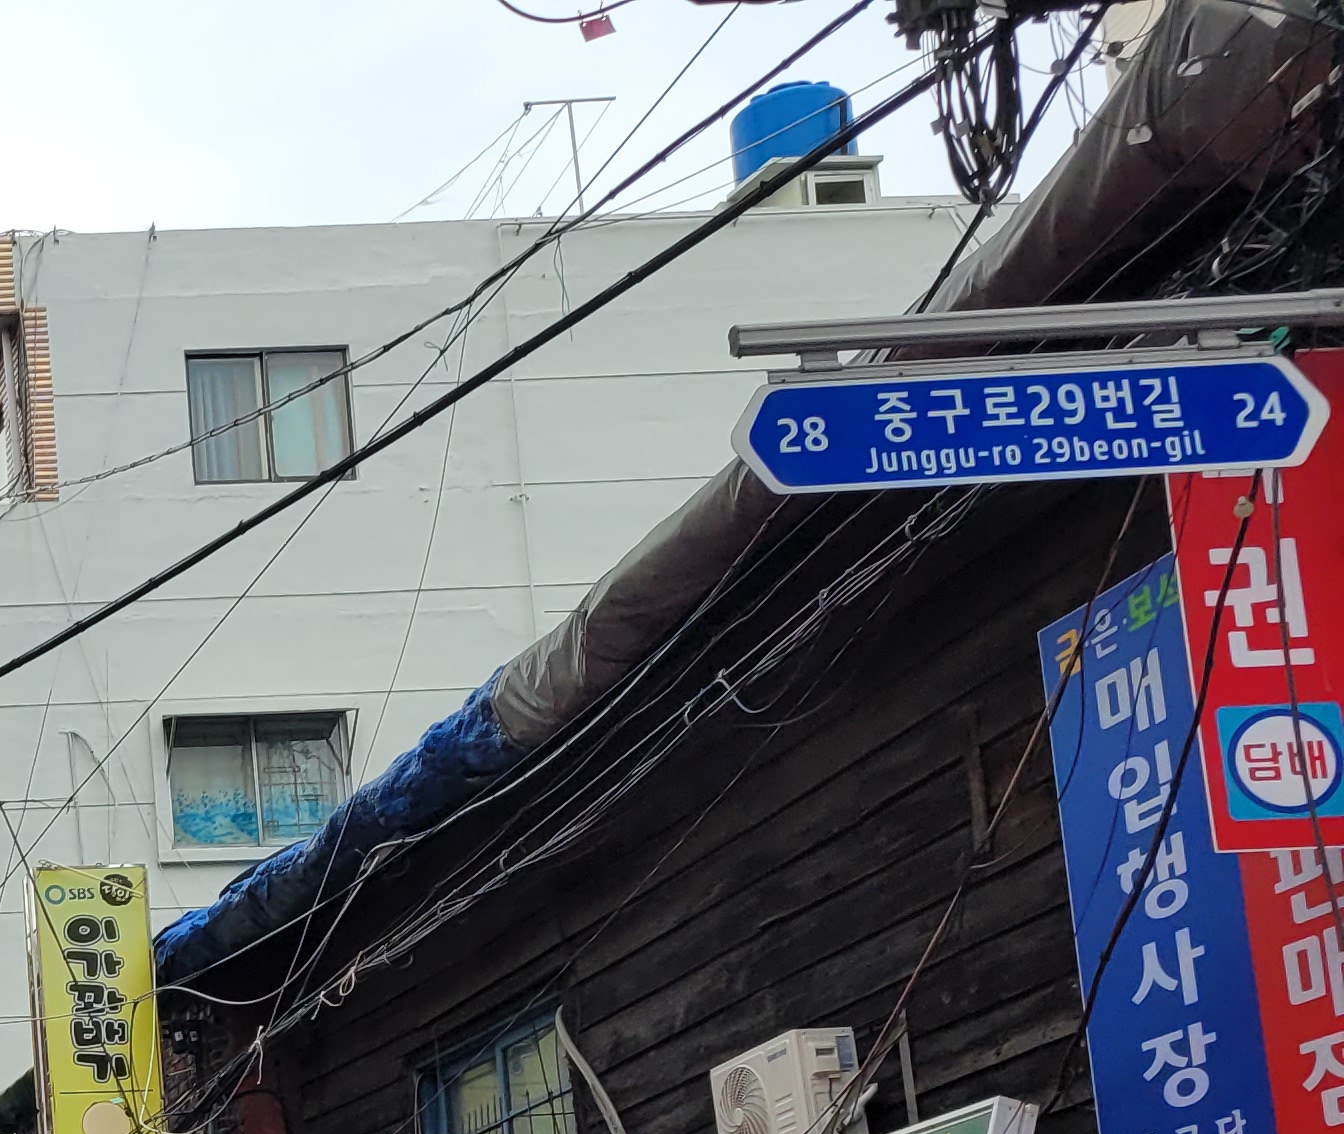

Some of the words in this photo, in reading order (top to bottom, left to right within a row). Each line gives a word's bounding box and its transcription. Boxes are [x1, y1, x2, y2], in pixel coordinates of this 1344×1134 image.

[777, 416, 830, 454] 28
[874, 376, 1186, 444] 중구로29번길
[1233, 391, 1287, 429] 24
[865, 444, 1022, 476] Junggu-ro
[1034, 429, 1206, 464] 29beon-gil
[1243, 740, 1328, 782] 담배
[68, 888, 95, 900] SBS
